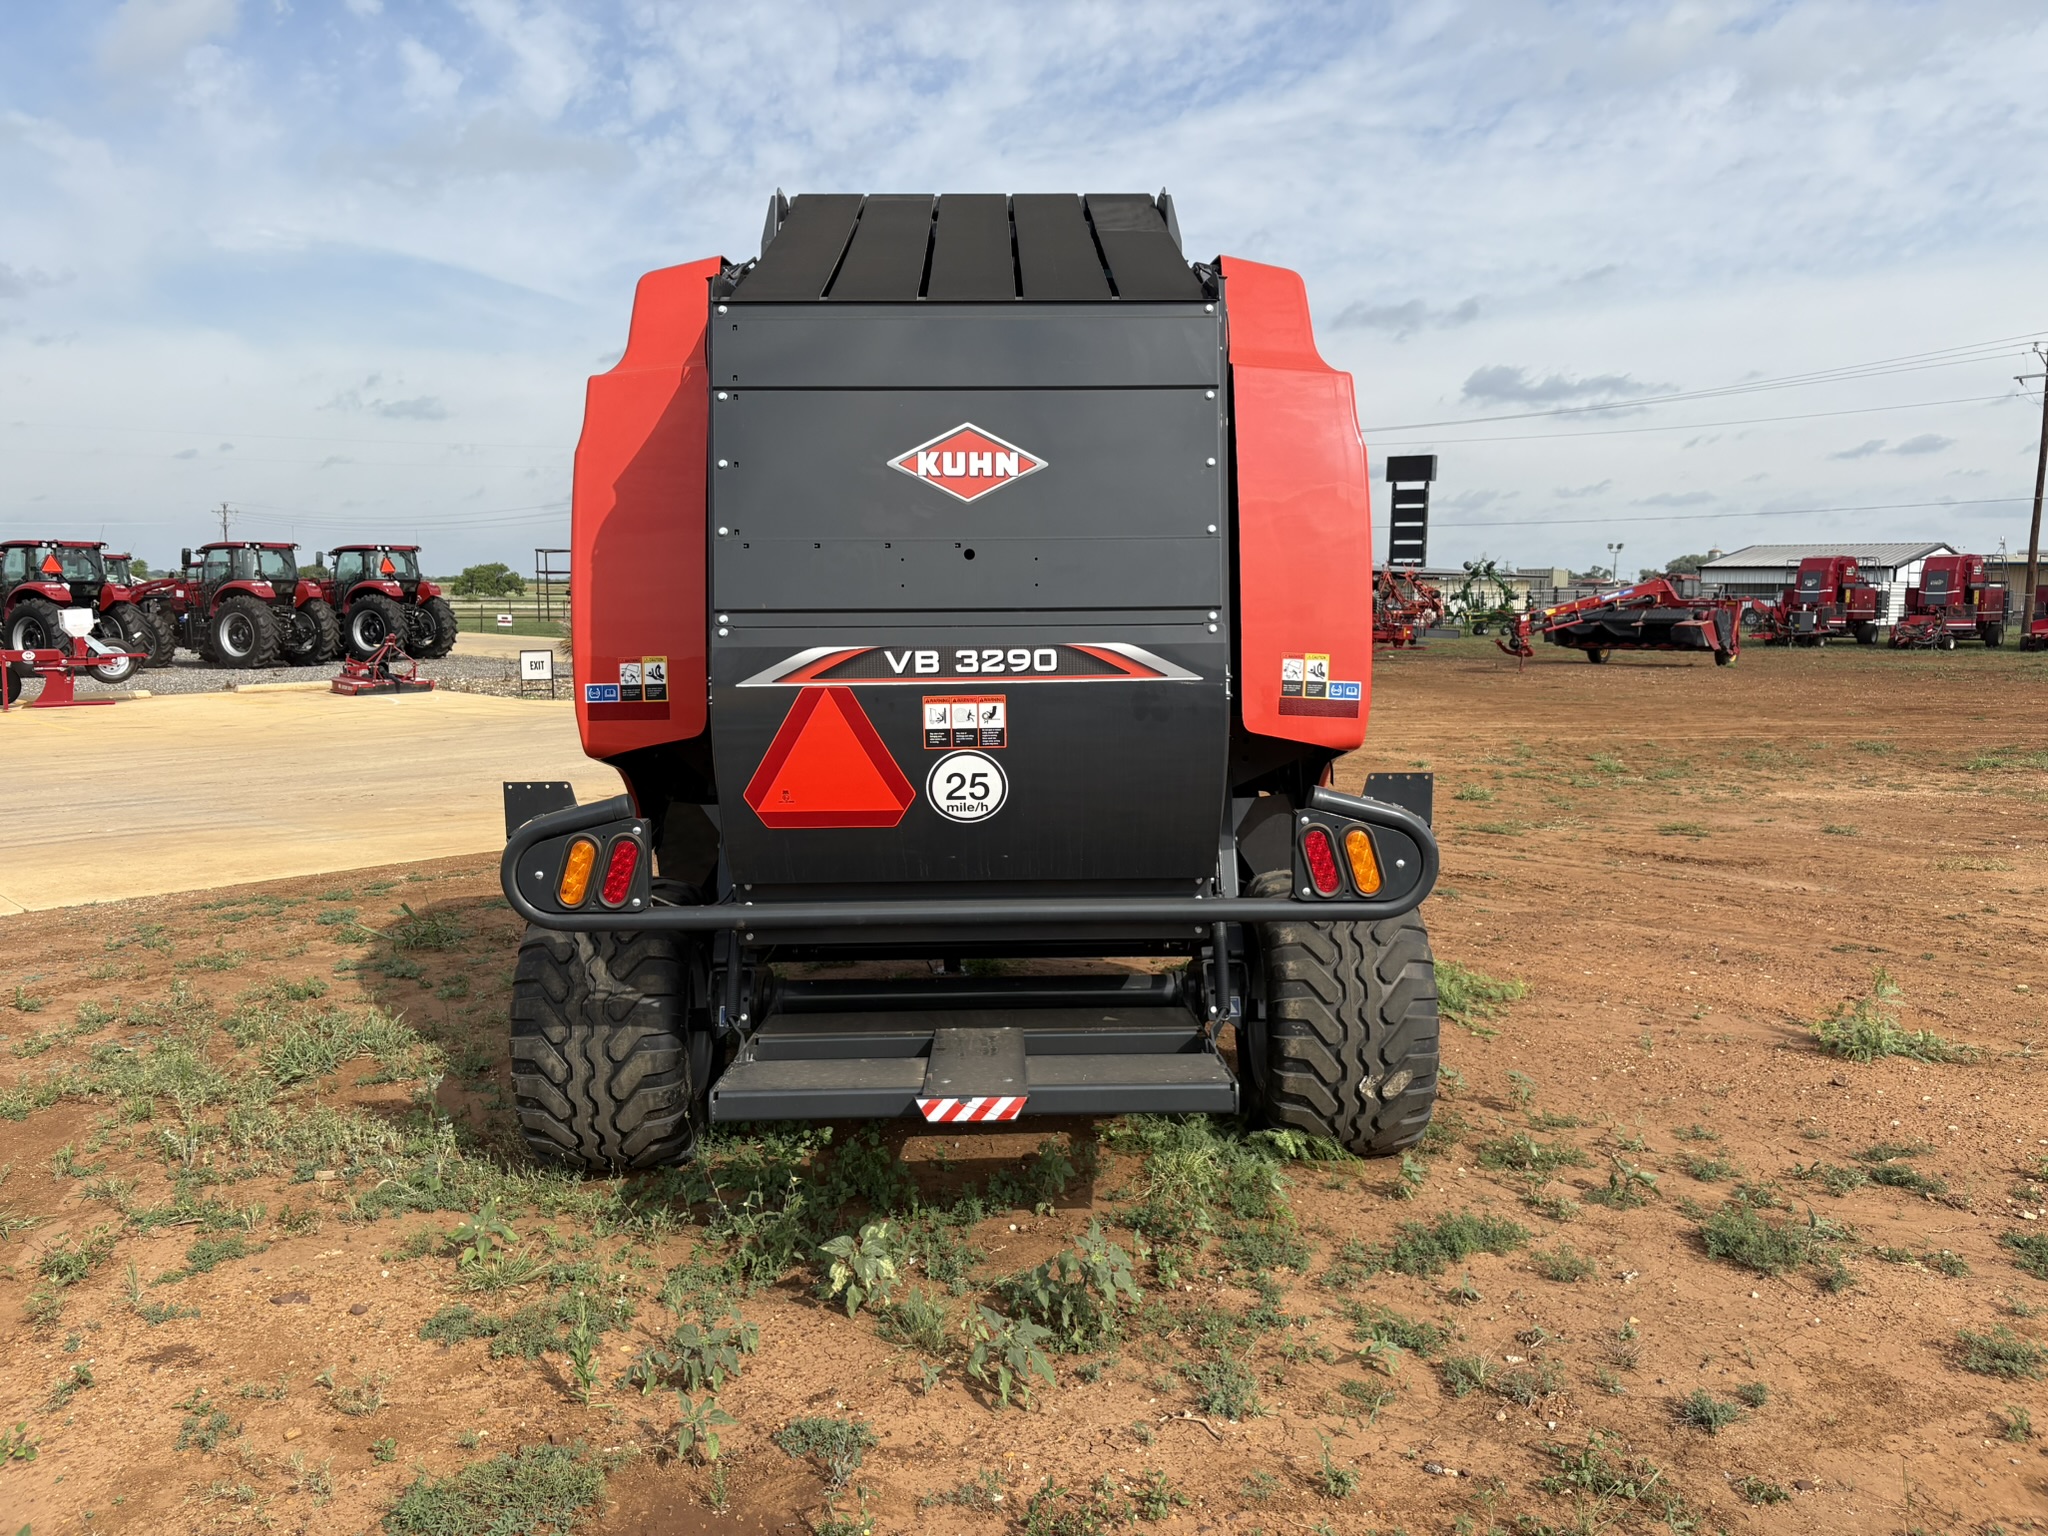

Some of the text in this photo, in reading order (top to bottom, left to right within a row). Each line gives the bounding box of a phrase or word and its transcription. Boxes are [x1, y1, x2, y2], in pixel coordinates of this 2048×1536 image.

[917, 451, 1019, 478] KUHN
[529, 660, 545, 671] EXIT
[884, 648, 1058, 675] VB 3290
[945, 772, 990, 801] 25
[946, 802, 989, 812] mile/h
